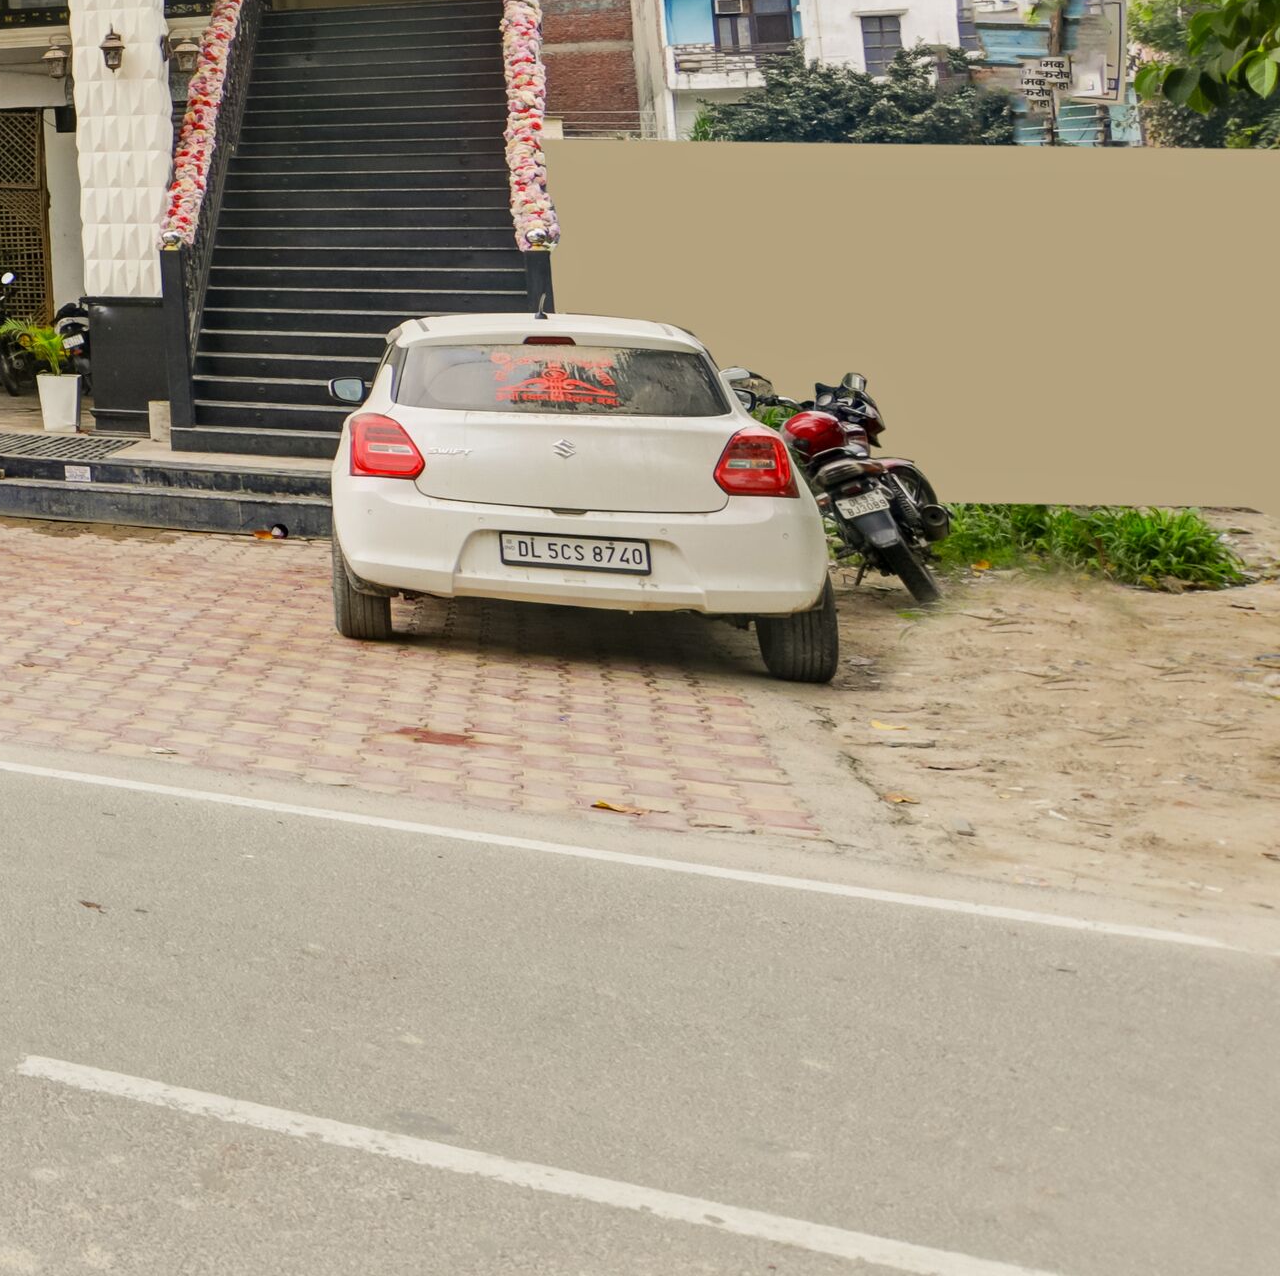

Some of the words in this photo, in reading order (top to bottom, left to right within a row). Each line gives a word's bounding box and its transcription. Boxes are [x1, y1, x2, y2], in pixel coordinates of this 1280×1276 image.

[429, 447, 473, 455] SWIFT
[518, 540, 541, 558] DL
[548, 542, 584, 561] 5CS
[592, 546, 643, 565] 8740
